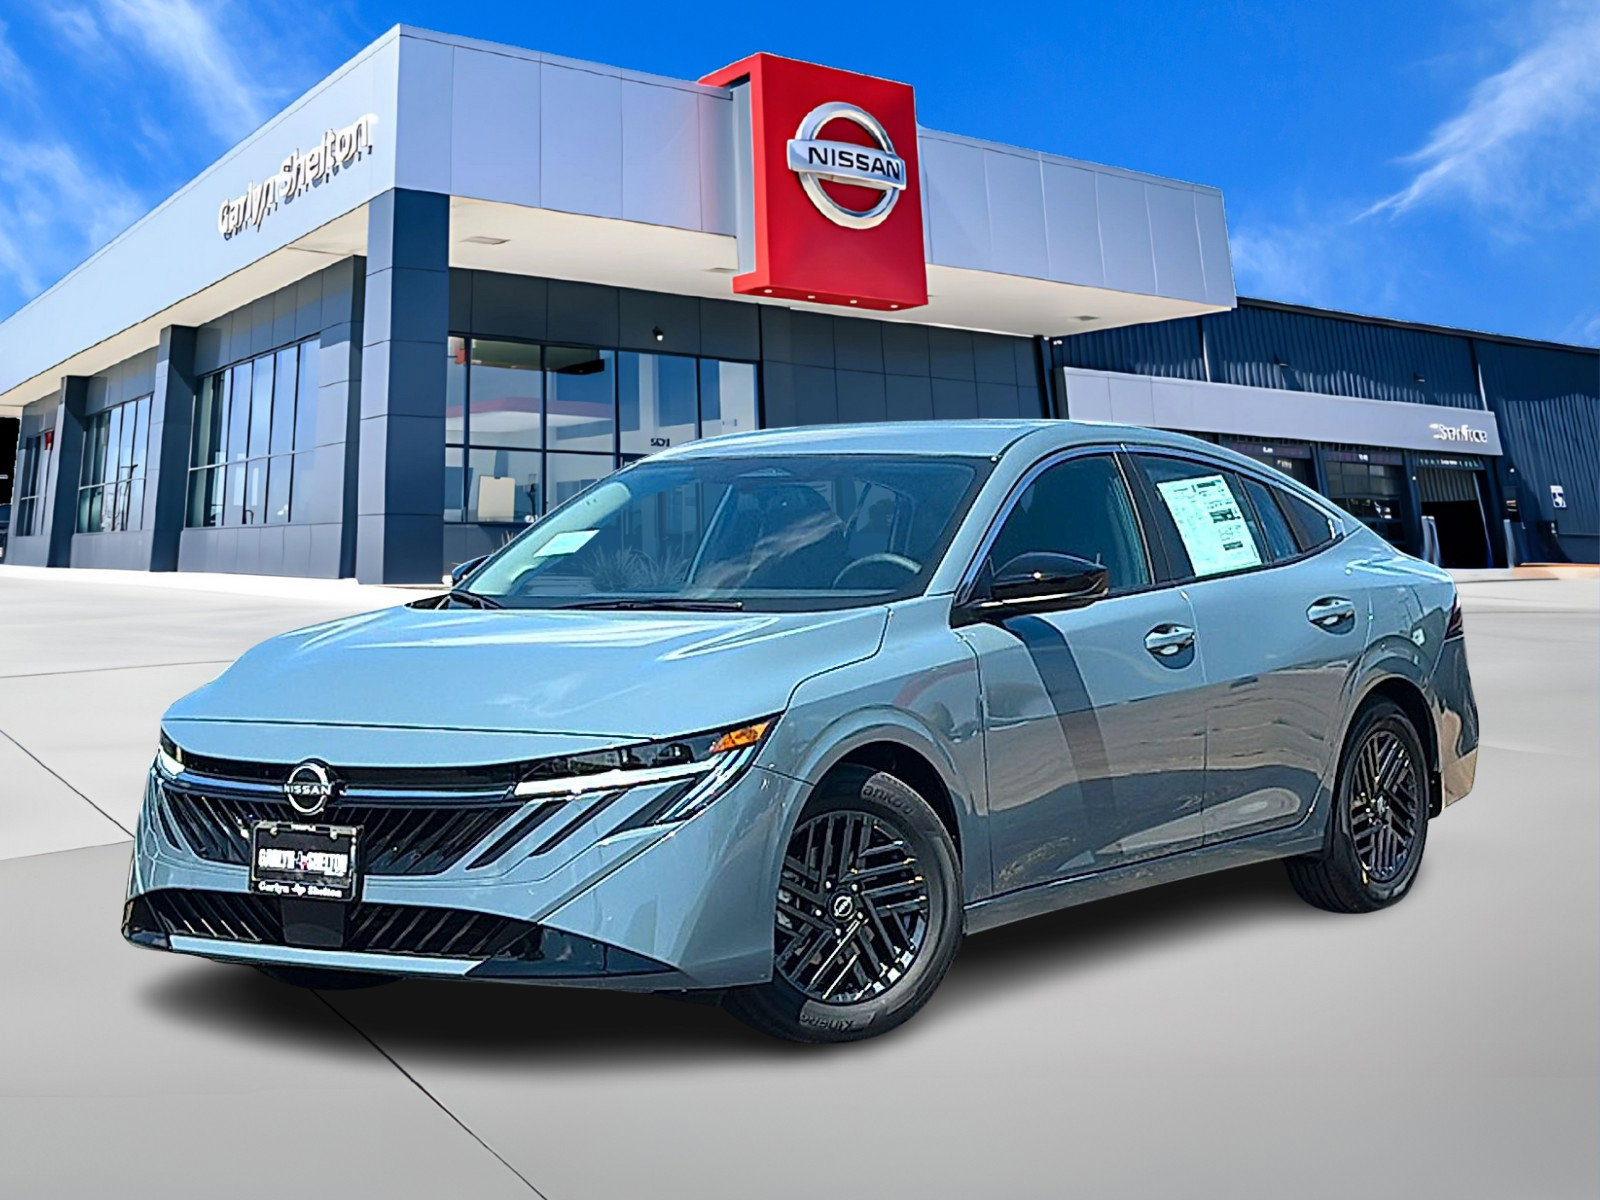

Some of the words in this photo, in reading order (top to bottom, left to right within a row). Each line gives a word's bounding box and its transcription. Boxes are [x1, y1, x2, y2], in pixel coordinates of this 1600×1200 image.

[279, 114, 374, 202] Shelton
[808, 146, 900, 180] NISSAN
[283, 783, 332, 796] NISSAN
